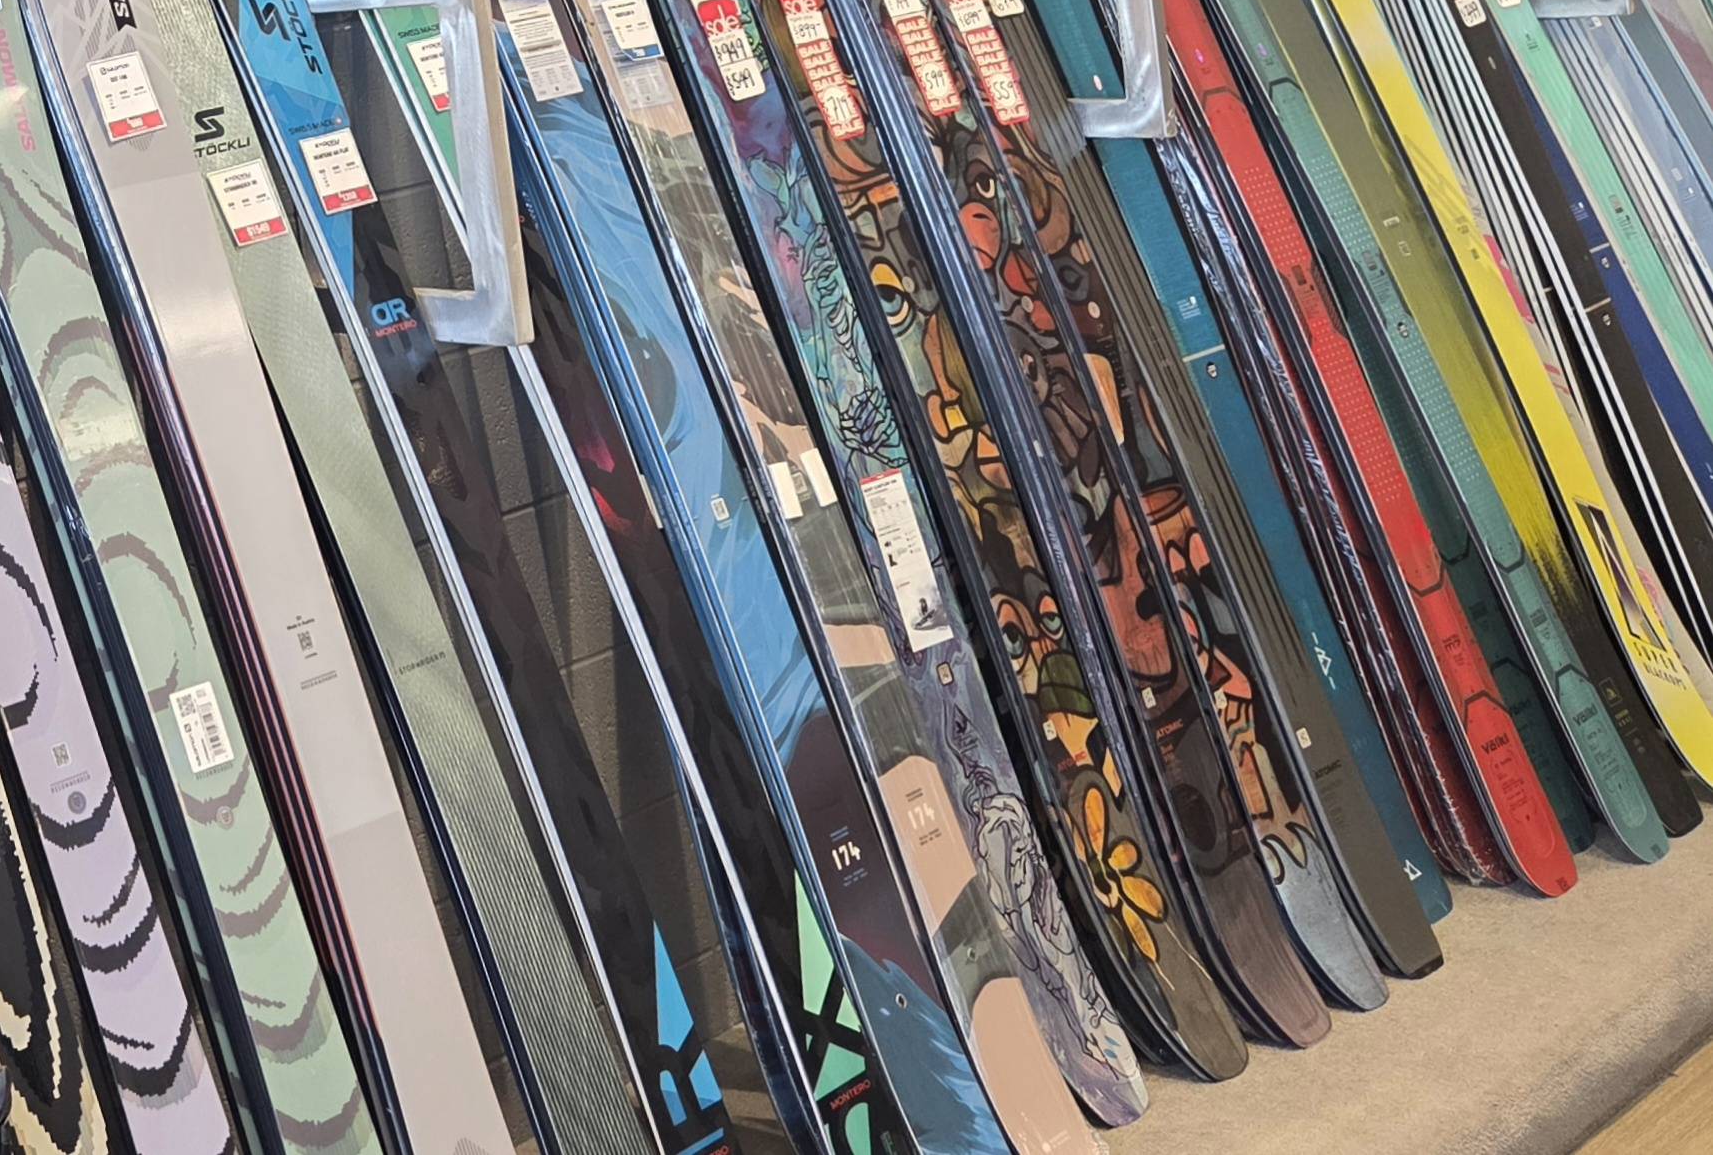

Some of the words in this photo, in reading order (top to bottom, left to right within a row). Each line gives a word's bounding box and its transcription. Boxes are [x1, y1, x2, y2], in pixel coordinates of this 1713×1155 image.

[1155, 718, 1184, 740] ATOMIC
[907, 803, 935, 830] 174
[831, 841, 861, 871] 174
[830, 1079, 871, 1110] MONTERO
